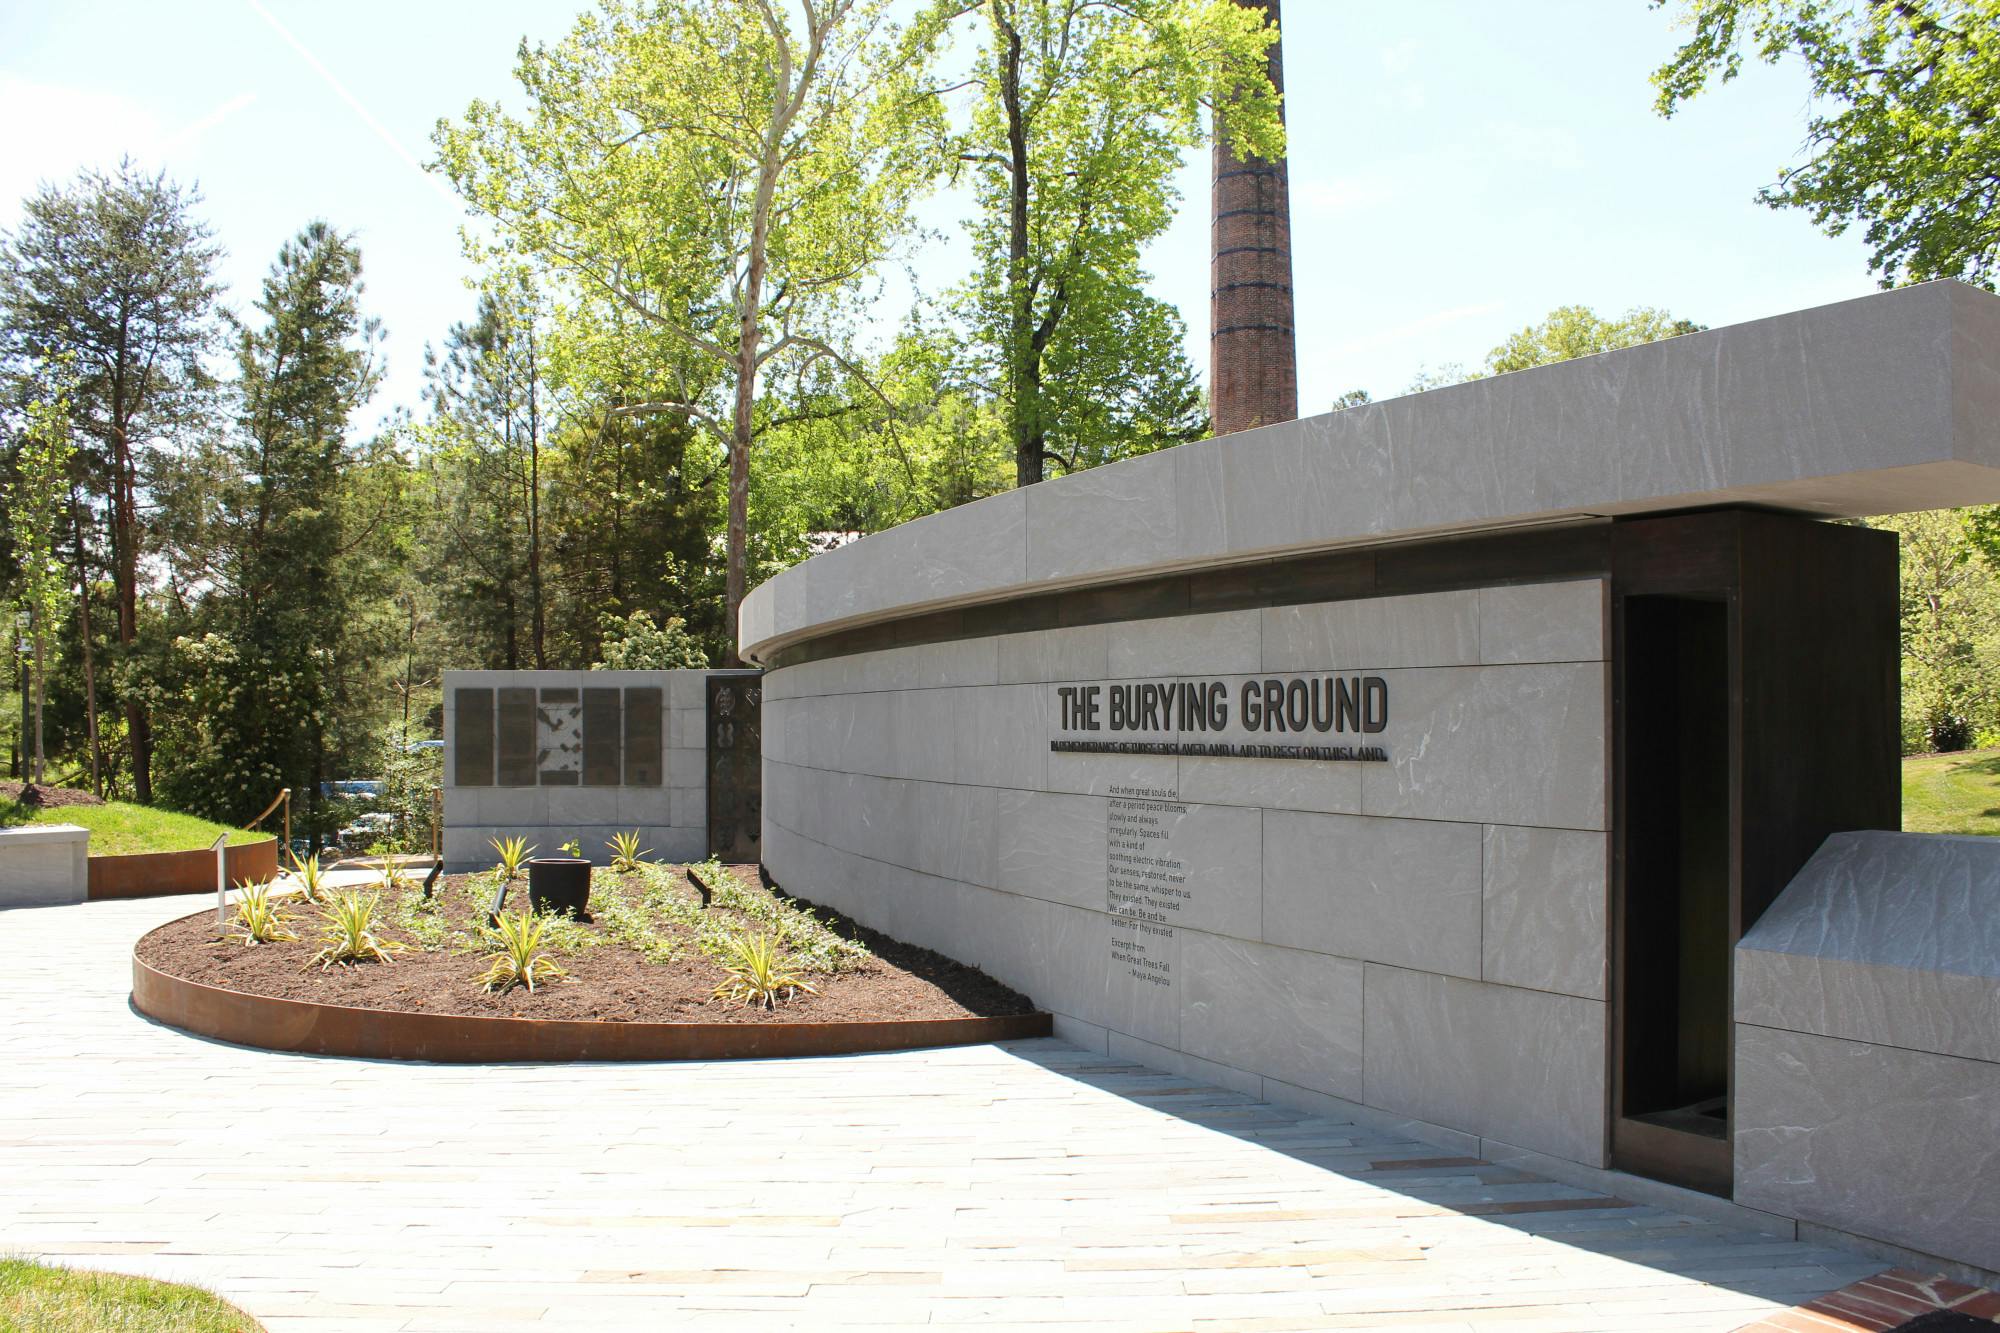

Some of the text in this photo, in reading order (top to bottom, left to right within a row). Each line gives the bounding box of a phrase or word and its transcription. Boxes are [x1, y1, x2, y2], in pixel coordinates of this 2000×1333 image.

[1057, 676, 1389, 733] THE BURYING GROUND
[1131, 742, 1157, 754] THOSE
[1158, 743, 1206, 756] ENSLAVED
[1208, 744, 1228, 756] AND
[1231, 744, 1257, 757] LAID
[1258, 745, 1271, 758] TO
[1273, 745, 1301, 758] REST
[1303, 746, 1319, 759] ON
[1320, 746, 1348, 760] THIS
[1349, 747, 1387, 761] LAND.
[1109, 785, 1119, 794] And
[1136, 788, 1150, 797] great
[1128, 801, 1145, 810] period
[1147, 804, 1162, 812] peace
[1128, 813, 1137, 822] and
[1139, 815, 1158, 825] always
[1139, 828, 1160, 839] Spaces
[1109, 839, 1120, 847] with
[1127, 841, 1137, 849] kind
[1139, 842, 1144, 850] of
[1110, 852, 1131, 864] soothing
[1133, 855, 1153, 865] electric
[1109, 865, 1119, 873] Our
[1120, 867, 1140, 878] senses,
[1169, 874, 1186, 883] never
[1116, 879, 1122, 887] be
[1123, 880, 1133, 889] the
[1152, 885, 1174, 896] whisper
[1176, 888, 1181, 897] to
[1109, 890, 1121, 902] They
[1145, 896, 1158, 908] They
[1109, 903, 1117, 912] We
[1139, 909, 1146, 918] Be
[1148, 911, 1158, 920] and
[1159, 914, 1166, 922] be
[1129, 921, 1138, 930] For
[1140, 922, 1151, 935] they
[1112, 937, 1145, 952] Excerpt from
[1111, 950, 1169, 972] When Great Trees Fall
[1132, 969, 1146, 981] Maya
[1148, 973, 1170, 986] Angelou
